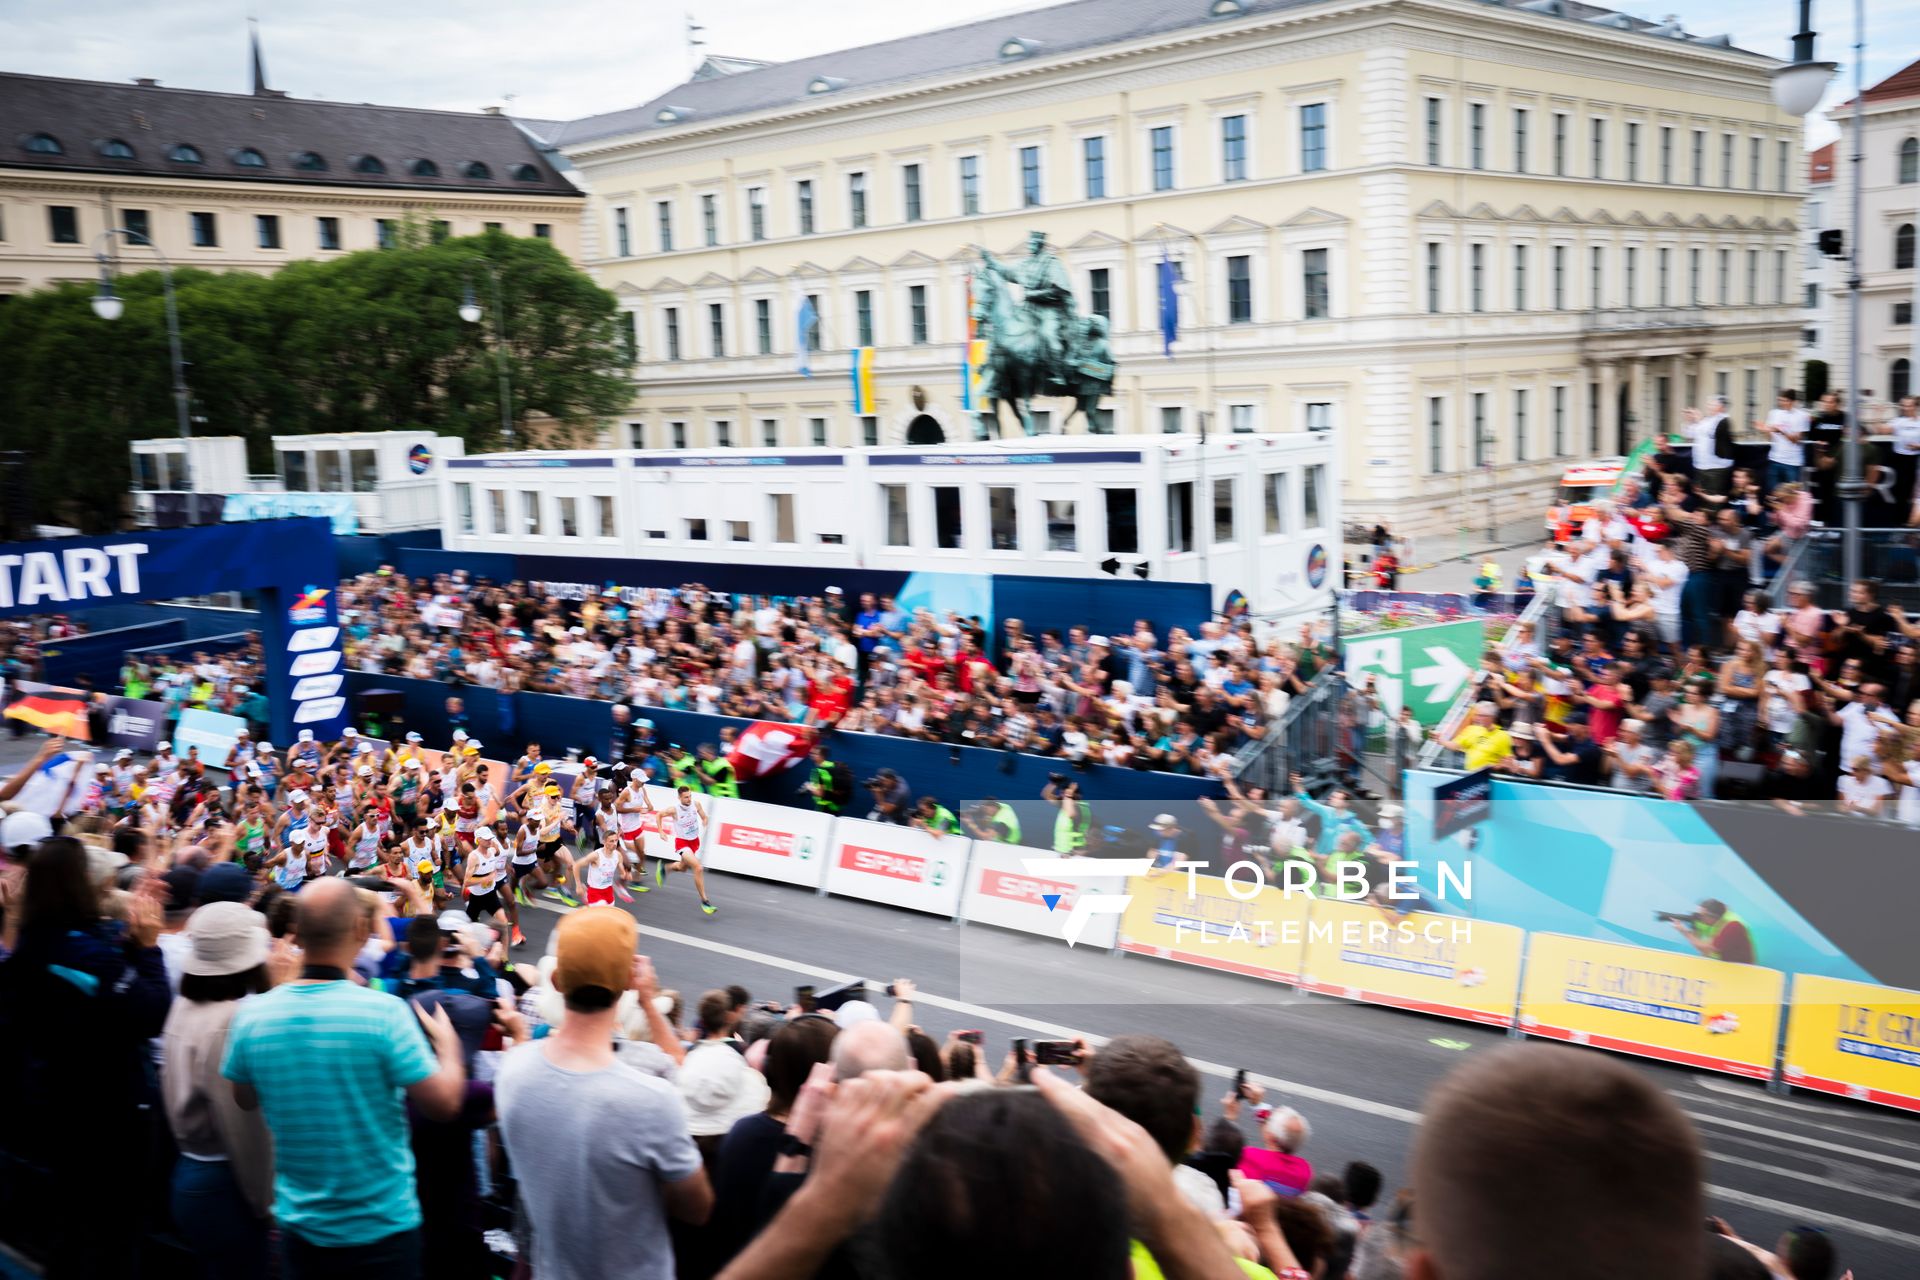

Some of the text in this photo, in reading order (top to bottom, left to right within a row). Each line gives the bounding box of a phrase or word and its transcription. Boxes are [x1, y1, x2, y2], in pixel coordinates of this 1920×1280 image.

[730, 828, 794, 853] SPAR
[854, 851, 926, 880] SPAR
[1839, 1004, 1871, 1037] LE
